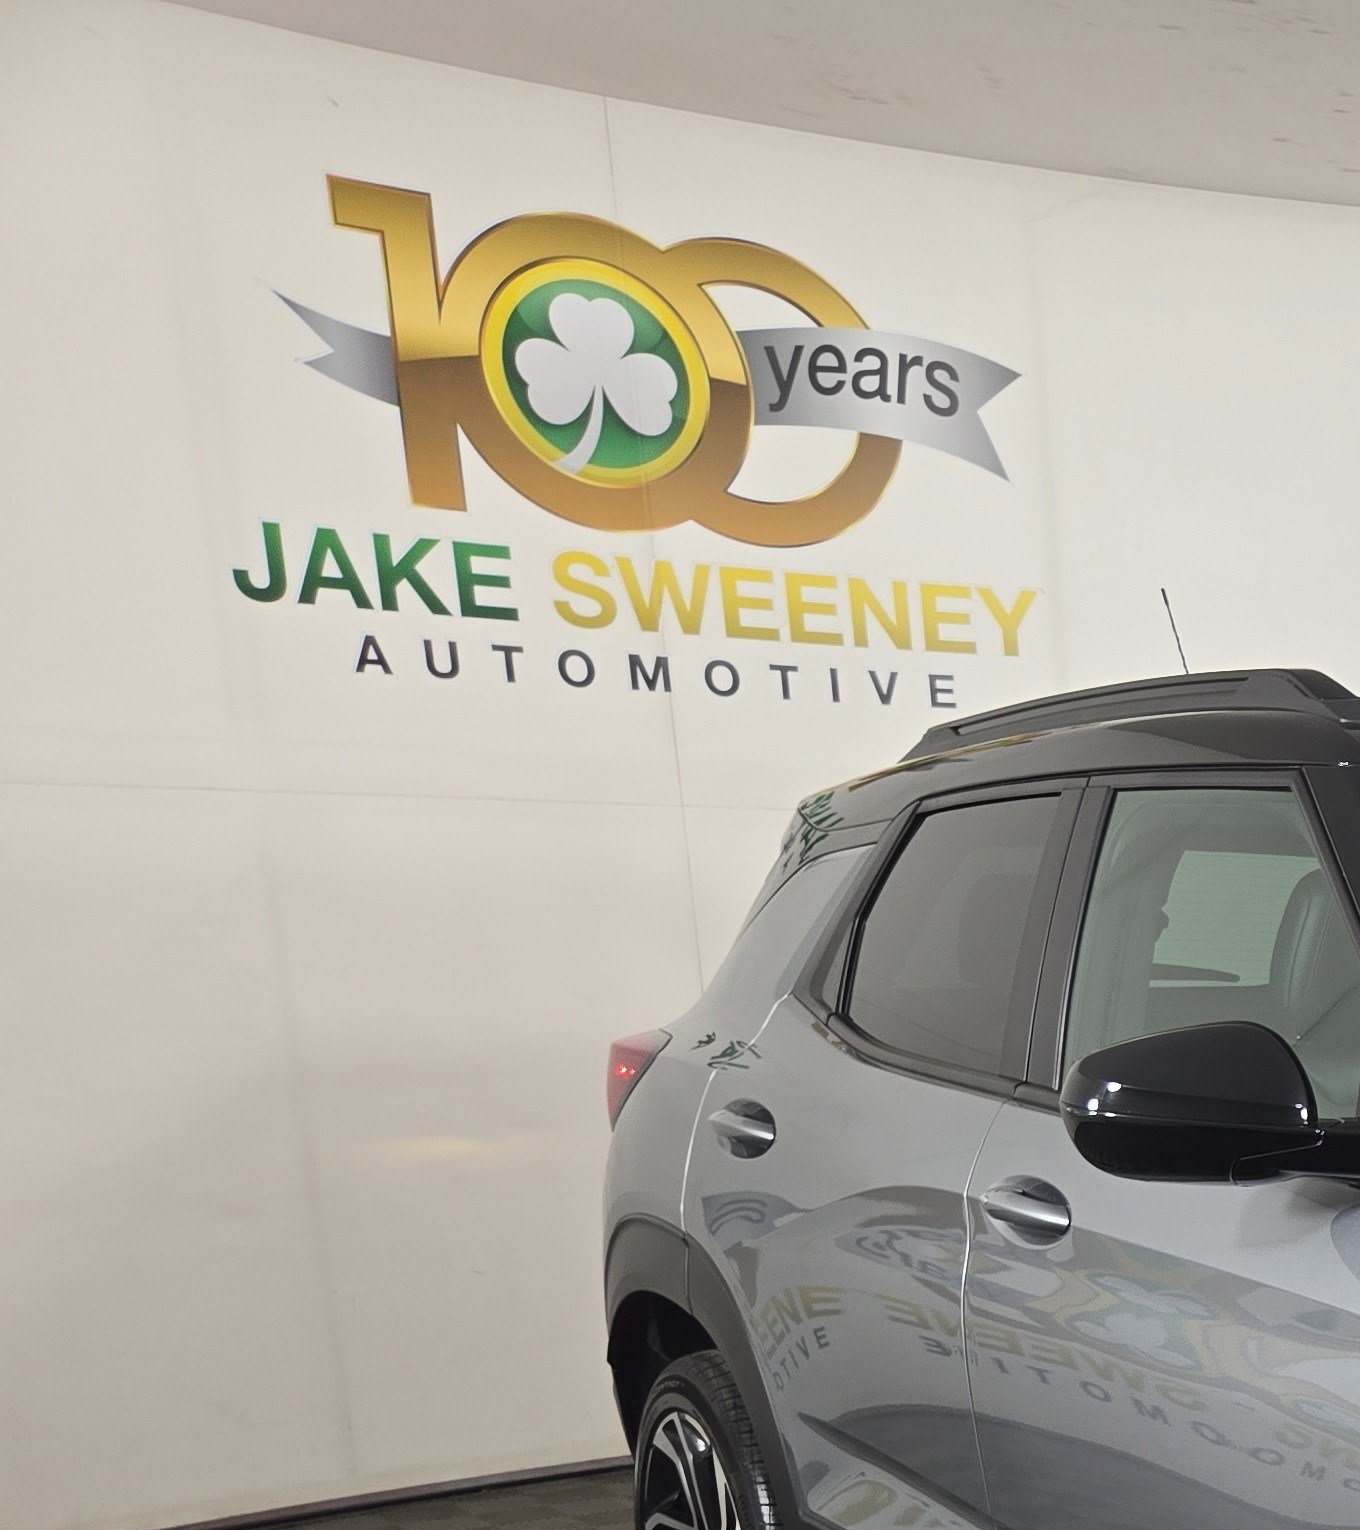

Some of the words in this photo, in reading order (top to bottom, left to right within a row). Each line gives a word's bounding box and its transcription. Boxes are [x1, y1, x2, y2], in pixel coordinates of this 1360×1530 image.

[764, 341, 960, 418] years
[232, 521, 520, 623] JAKE
[551, 550, 1038, 658] SWEENEY
[354, 634, 958, 709] AUTOMOTIVE
